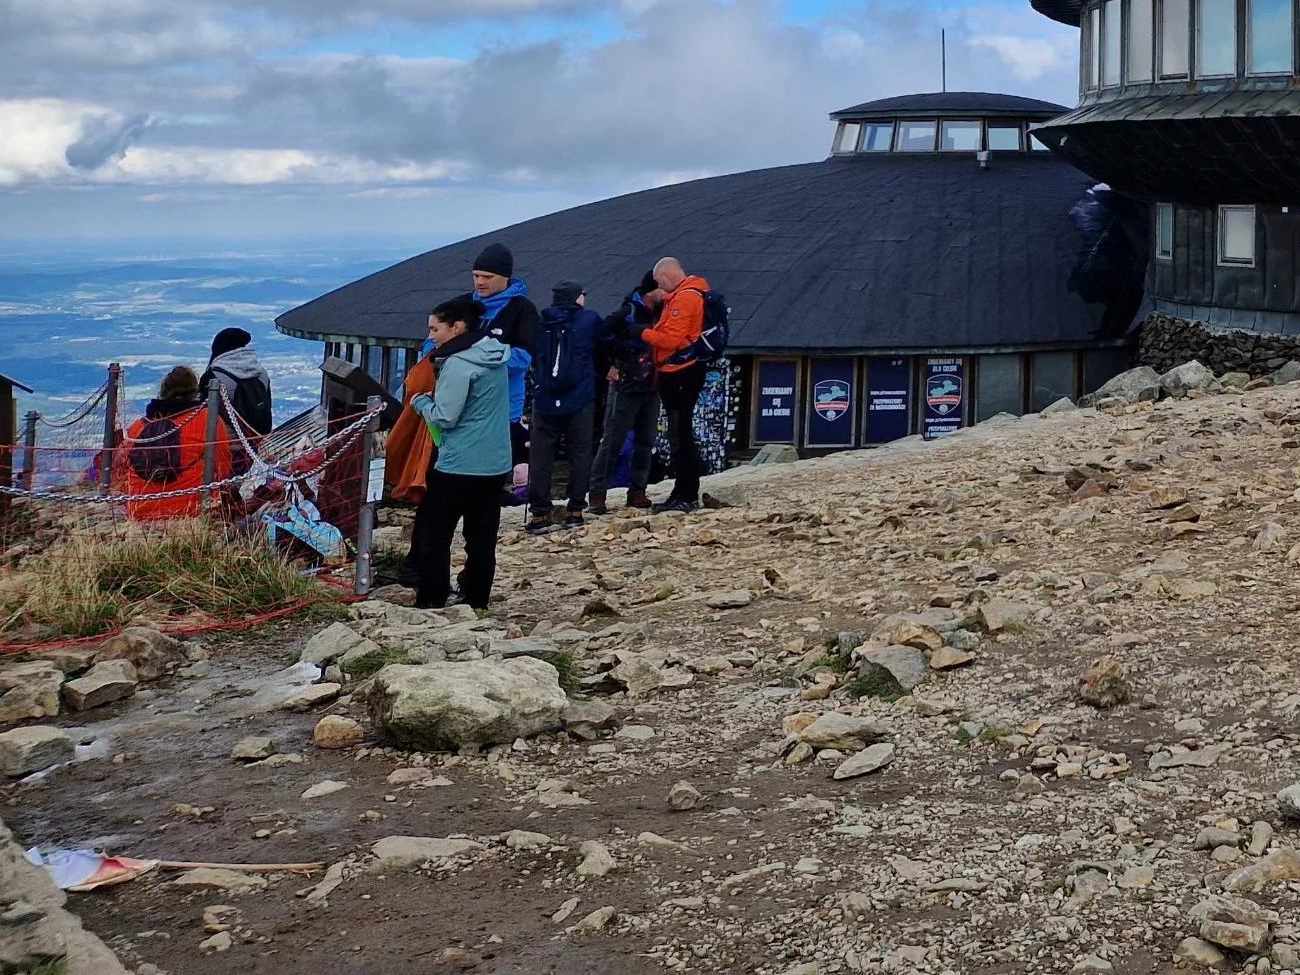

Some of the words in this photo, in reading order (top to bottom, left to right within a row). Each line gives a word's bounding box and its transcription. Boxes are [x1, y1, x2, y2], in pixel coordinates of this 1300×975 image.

[762, 386, 793, 395] ZMIENIAMY
[772, 397, 782, 408] SIĘ
[761, 408, 773, 417] DLA
[773, 408, 791, 416] CIEBIE
